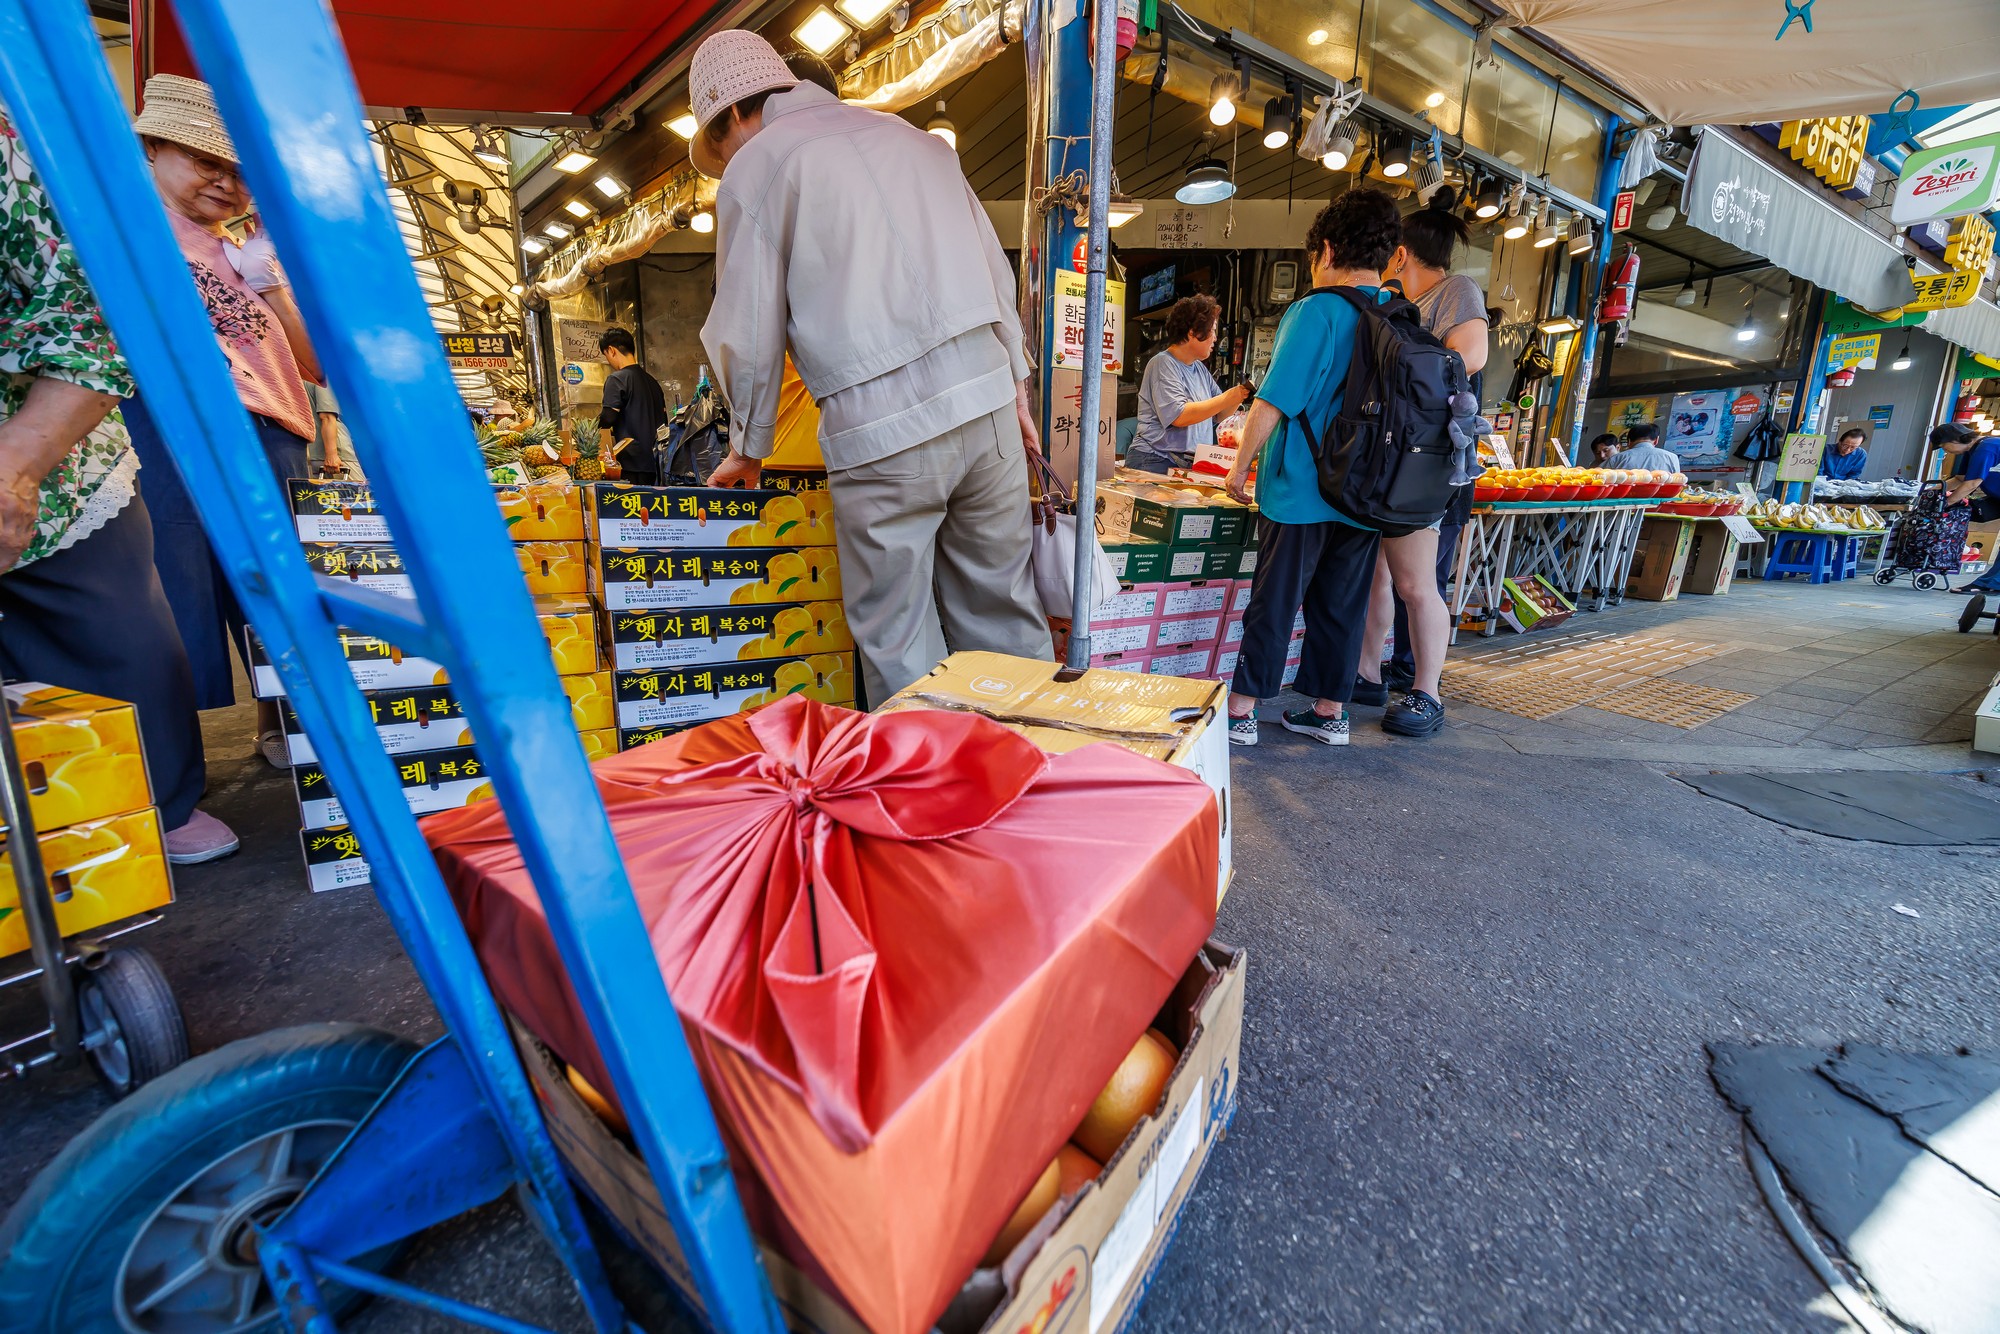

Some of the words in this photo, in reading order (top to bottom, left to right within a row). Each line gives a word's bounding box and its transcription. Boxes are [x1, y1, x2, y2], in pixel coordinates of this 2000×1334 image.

[1912, 167, 1978, 196] Zespri
[1928, 187, 1960, 197] KIWIFRUIT
[477, 337, 505, 353] 보상
[1834, 338, 1876, 351] 우리동네
[463, 357, 508, 368] 1566-3709
[316, 491, 376, 514] 햇사
[621, 494, 698, 518] 햇사레
[708, 500, 758, 517] 복숭아
[625, 556, 702, 581] 햇사레
[711, 559, 761, 576] 복숭아
[636, 615, 710, 641] 햇사레
[719, 615, 767, 632] 복숭아
[638, 671, 712, 699] 햇사레
[722, 672, 765, 688] 복숭아
[980, 679, 1008, 691] Dole
[438, 759, 481, 777] 복숭
